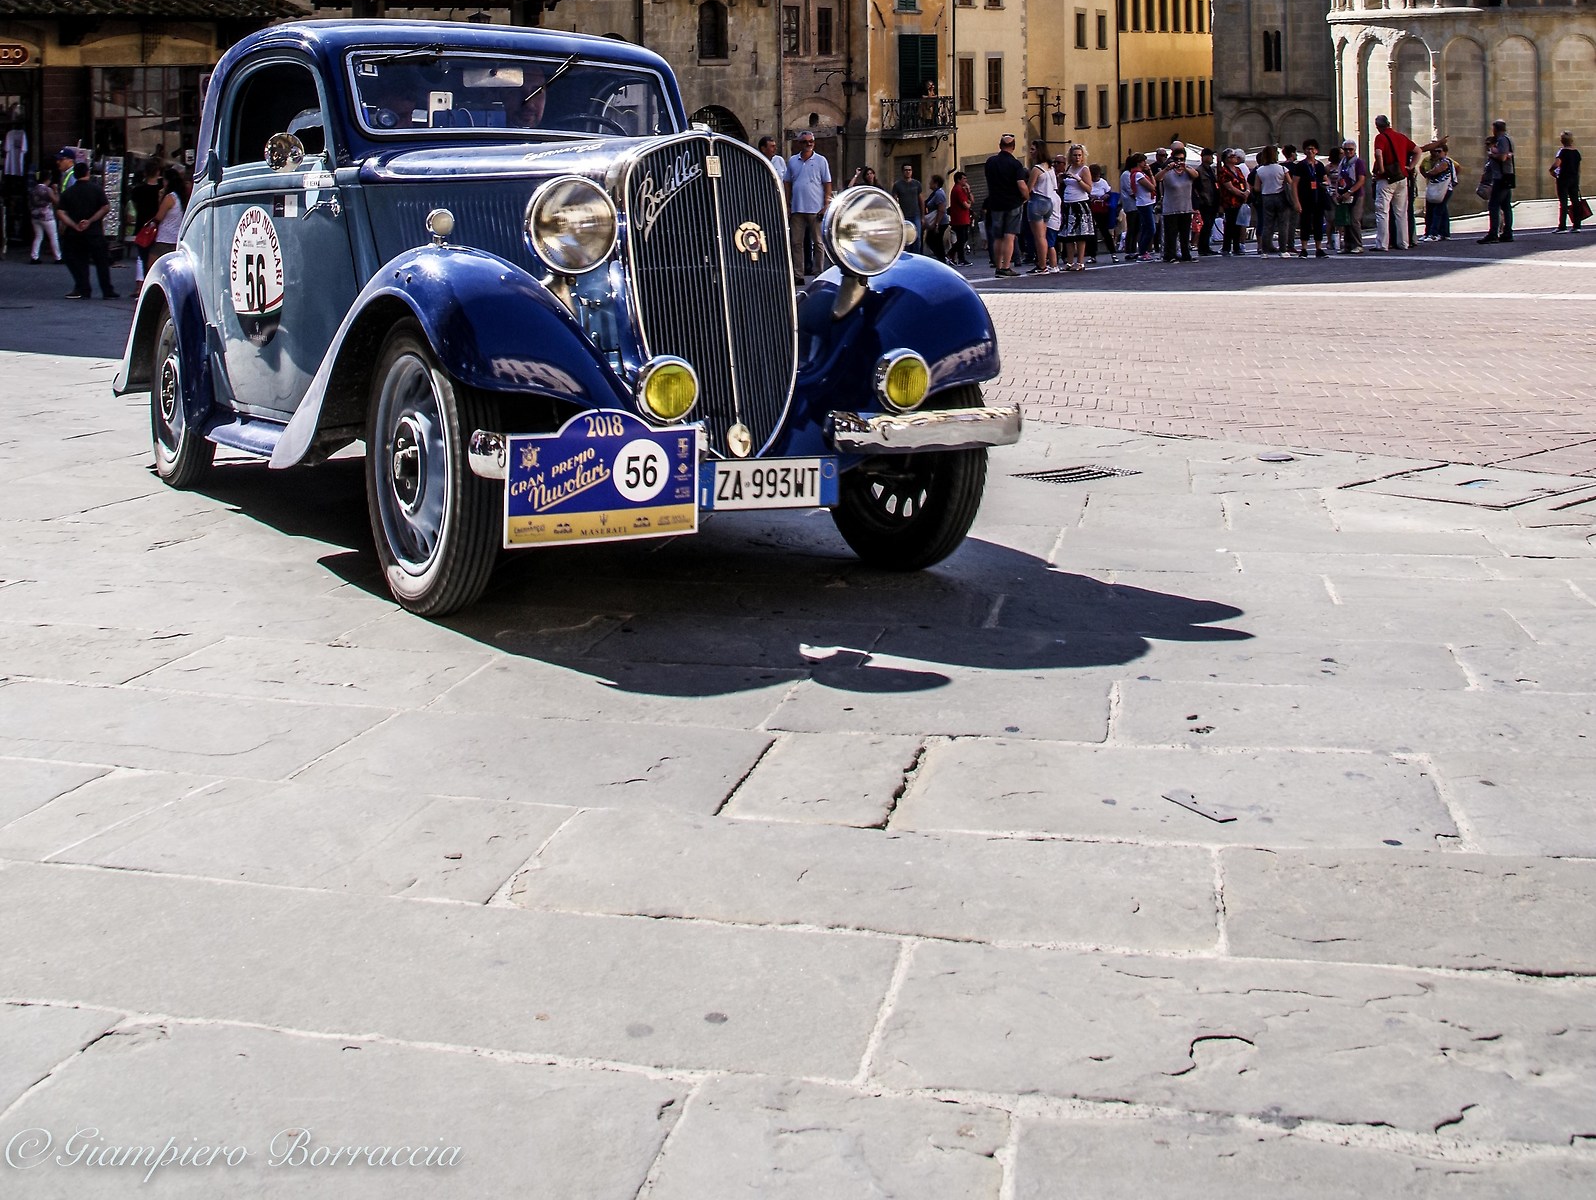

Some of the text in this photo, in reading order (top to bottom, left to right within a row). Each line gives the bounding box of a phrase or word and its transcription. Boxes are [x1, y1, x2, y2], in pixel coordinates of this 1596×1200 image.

[634, 150, 703, 242] Balilla
[231, 209, 283, 286] GRAN PREMIO NUVOLARI
[245, 253, 267, 314] 56
[585, 415, 624, 437] 2018
[510, 447, 595, 496] GRAN PREMIO
[528, 458, 611, 511] Nuvolari
[625, 454, 658, 489] 56
[717, 467, 819, 501] ZA 993WT
[580, 526, 627, 536] MASERATI
